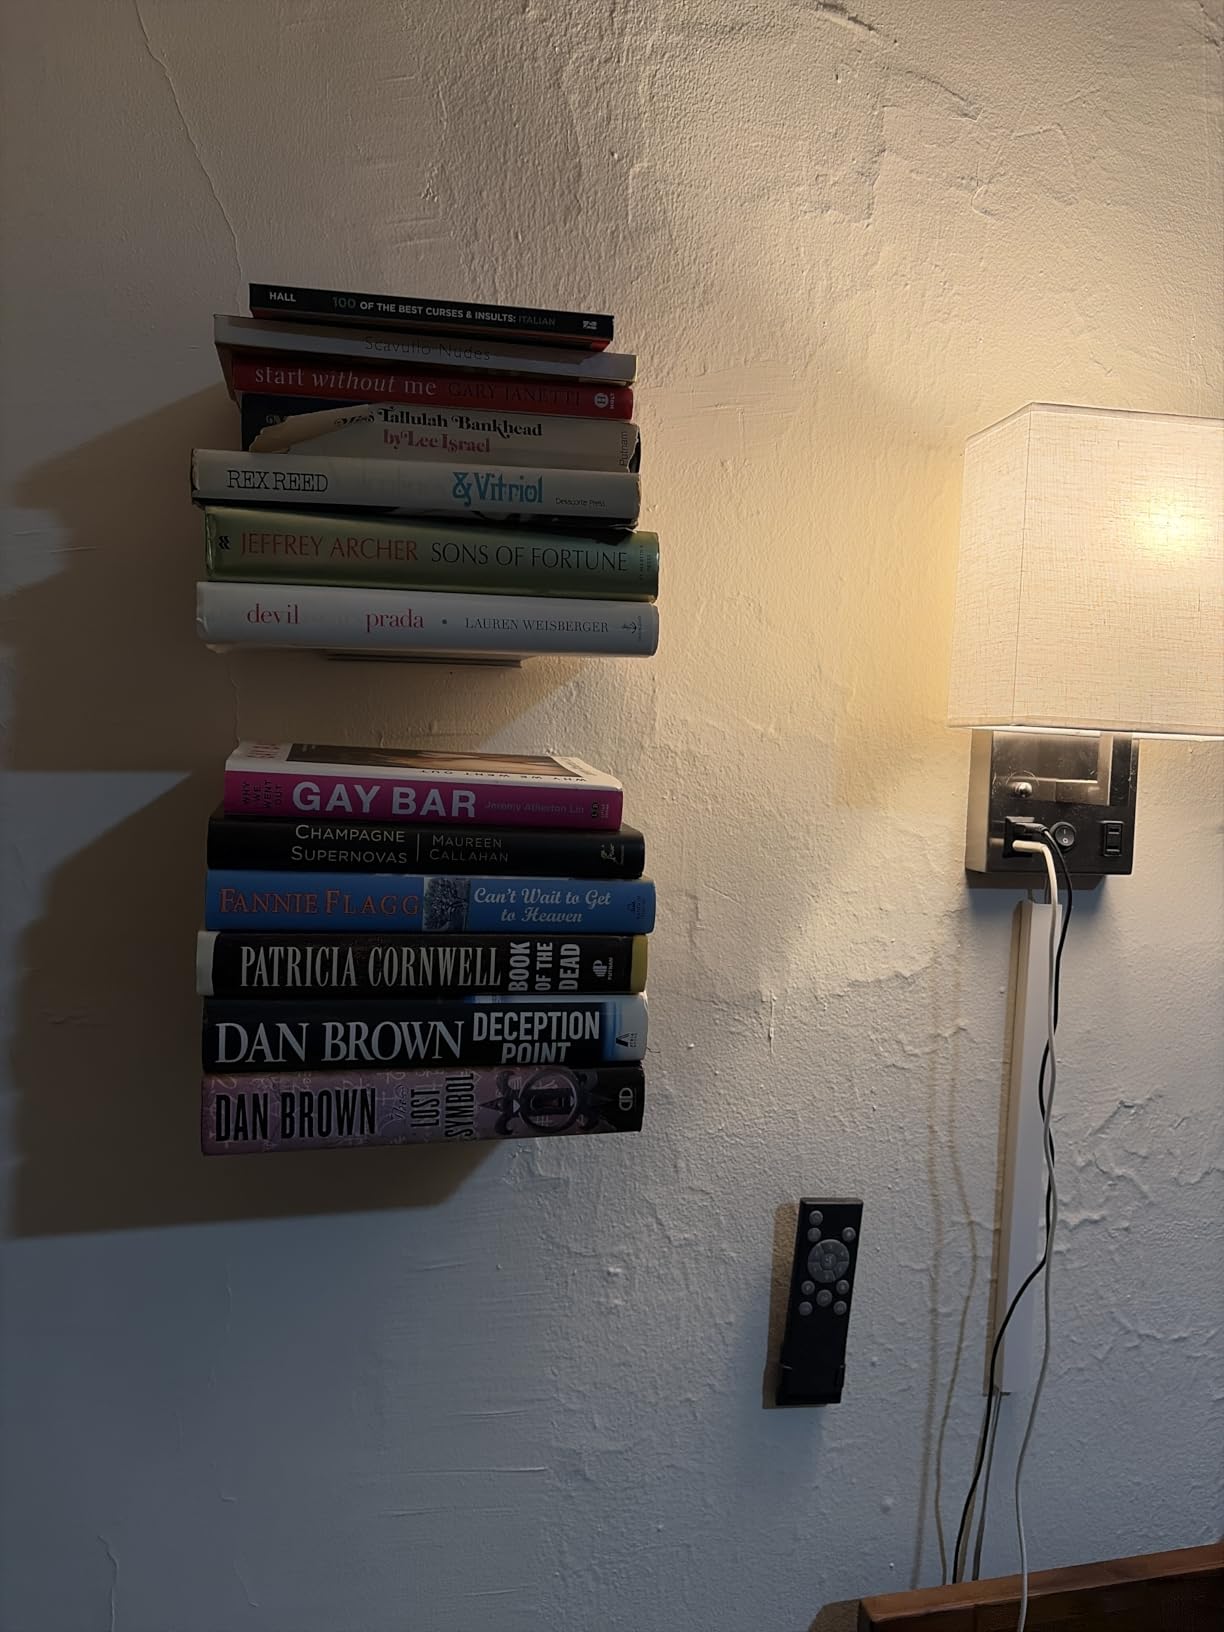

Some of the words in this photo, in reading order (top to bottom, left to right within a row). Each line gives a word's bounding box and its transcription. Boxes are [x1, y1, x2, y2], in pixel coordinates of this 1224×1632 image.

[269, 291, 297, 303] HALL
[332, 296, 357, 309] 100
[359, 301, 374, 311] OF
[376, 302, 396, 313] THE
[398, 304, 424, 315] BEST
[425, 306, 464, 319] CURSES
[465, 311, 473, 319] &
[474, 311, 517, 323] INSULTS:
[517, 314, 557, 326] ITALIAN
[365, 336, 432, 355] Scavullo
[439, 343, 491, 361] Nudes
[255, 364, 304, 387] start
[312, 367, 396, 393] without
[404, 379, 438, 397] me
[447, 382, 497, 400] GARY
[377, 406, 448, 428] Tallulah
[451, 415, 543, 439] Bankhead
[383, 428, 401, 449] by
[402, 430, 439, 449] Lee
[441, 434, 491, 453] Israel
[227, 470, 271, 490] REX
[272, 472, 329, 492] REED
[240, 533, 323, 557] JEFFREY
[329, 537, 419, 561] ARCHER
[431, 542, 489, 566] SONS
[495, 545, 525, 567] OF
[531, 547, 628, 572] FORTUNE
[247, 603, 301, 625] devil
[365, 608, 425, 633] prada
[465, 617, 518, 631] LAUREN
[521, 619, 609, 633] WEISBERGER
[291, 781, 382, 814] GAY
[391, 786, 477, 818] BAR
[294, 824, 406, 843] CHAMPAGNE
[432, 835, 503, 849] MAUREEN
[290, 845, 408, 865] SUPERNOVAS
[429, 848, 510, 863] CALLAHAN
[219, 888, 320, 914] FANNIE
[325, 888, 420, 916] FLAGG
[474, 887, 516, 905] Can't
[521, 887, 562, 906] Wait
[565, 891, 580, 906] to
[585, 889, 612, 911] Get
[501, 908, 516, 922] to
[521, 907, 583, 923] Heaven
[240, 946, 360, 988] PATRICIA
[368, 946, 502, 988] CORNWELL
[507, 941, 532, 993] BOOK
[536, 941, 553, 971] THE
[557, 942, 582, 992] DEAD
[534, 972, 552, 992] OF
[472, 1011, 601, 1042] DECEPTION
[214, 1021, 311, 1064] DAN
[320, 1019, 465, 1063] BROWN
[500, 1041, 572, 1065] POINT
[215, 1092, 269, 1142] DAN
[279, 1087, 376, 1140] BROWN
[410, 1087, 441, 1128] LOST
[445, 1072, 475, 1142] SYMBOL
